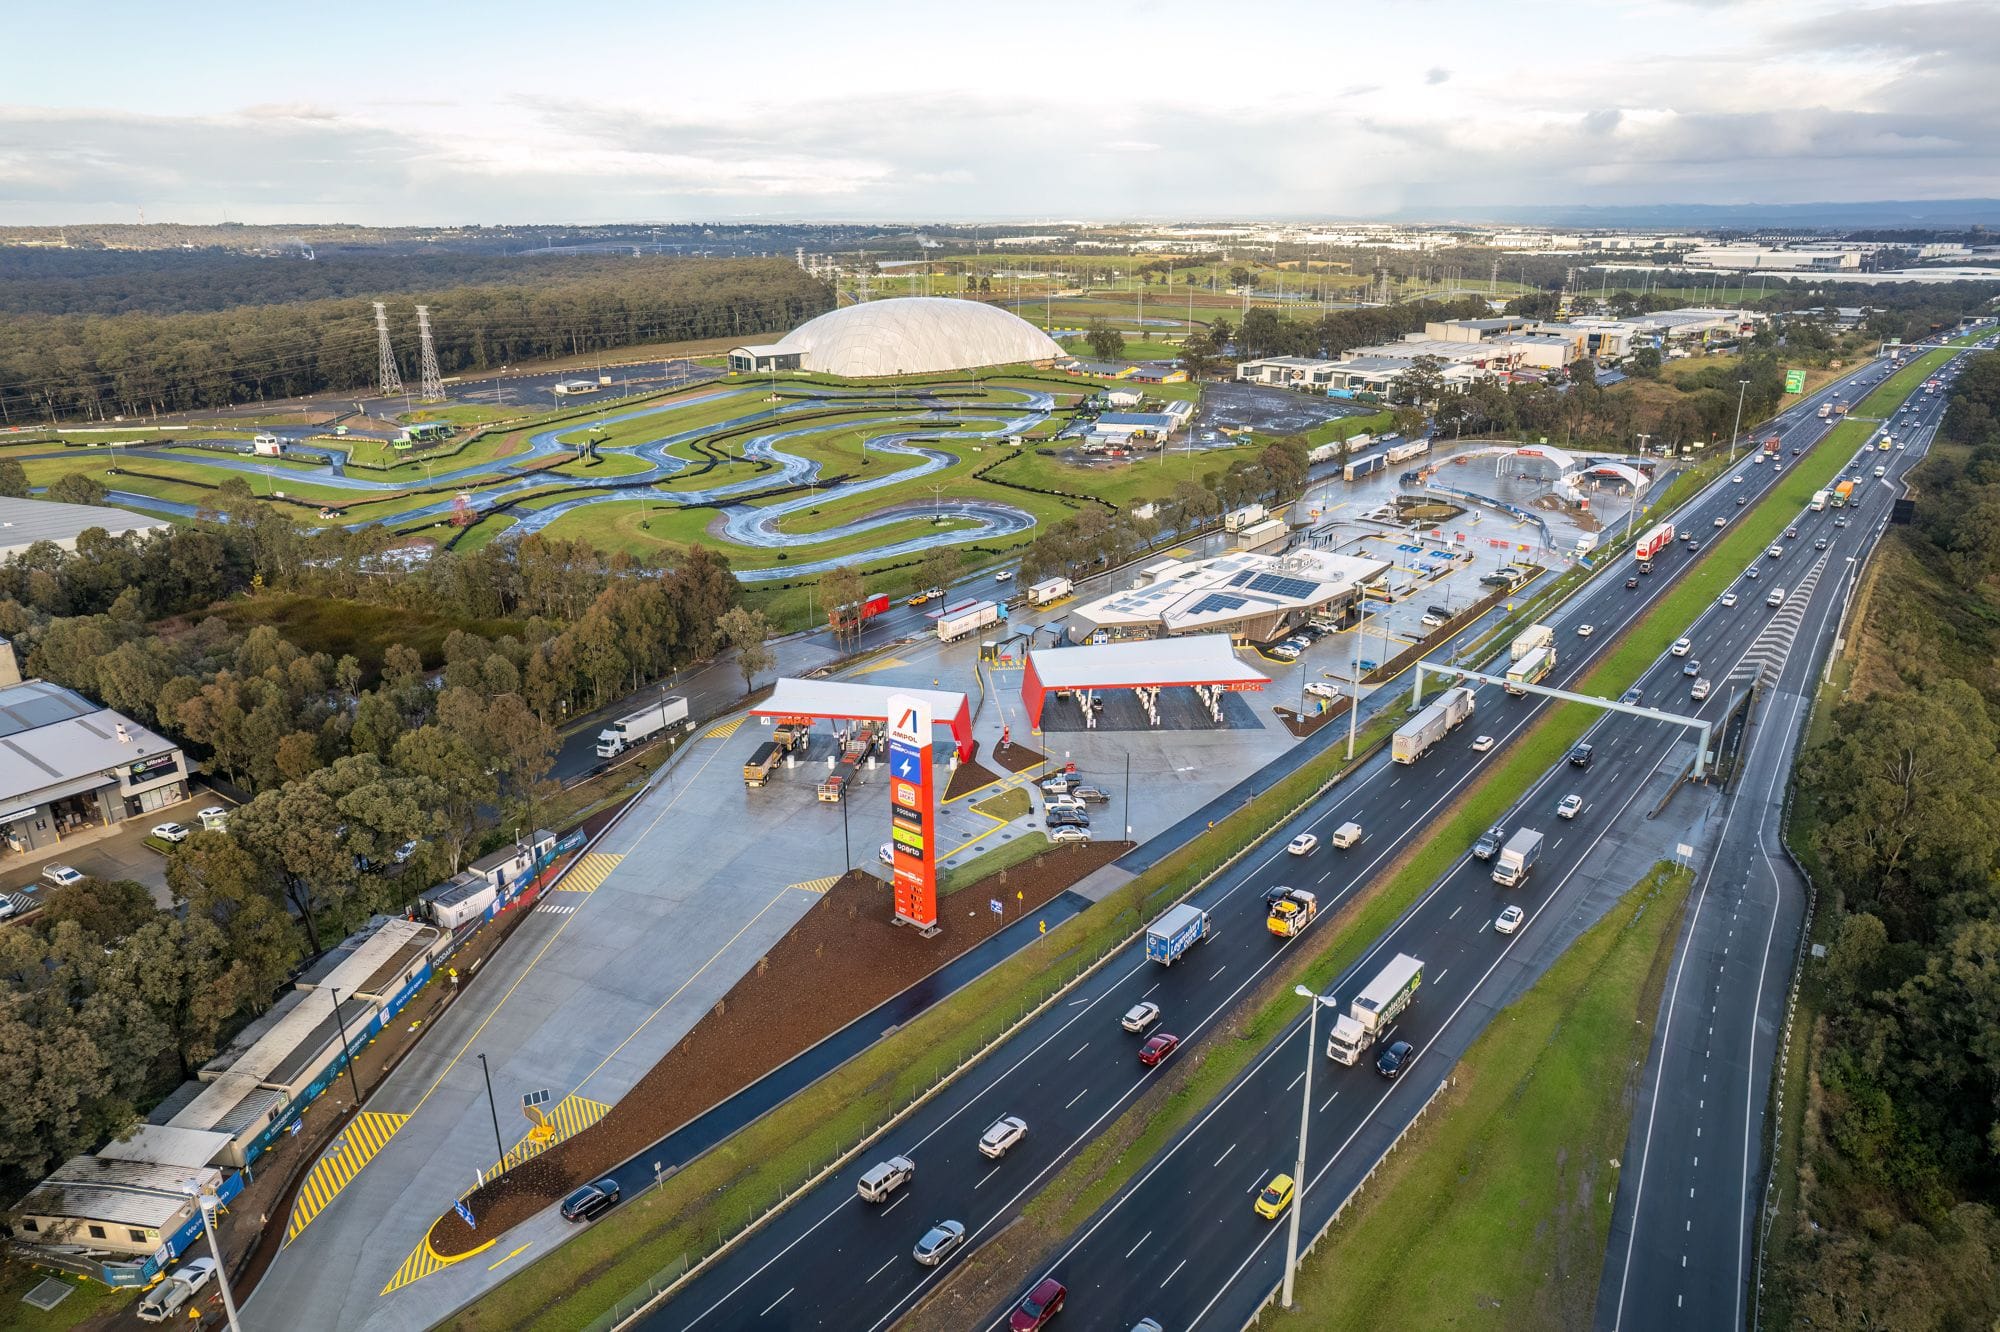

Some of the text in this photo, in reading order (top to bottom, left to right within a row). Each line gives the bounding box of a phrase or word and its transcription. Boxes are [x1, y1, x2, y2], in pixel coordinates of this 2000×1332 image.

[893, 730, 918, 743] AMPOL
[146, 756, 170, 766] UltraAir
[897, 843, 920, 856] oporto
[432, 944, 455, 969] FOODARY
